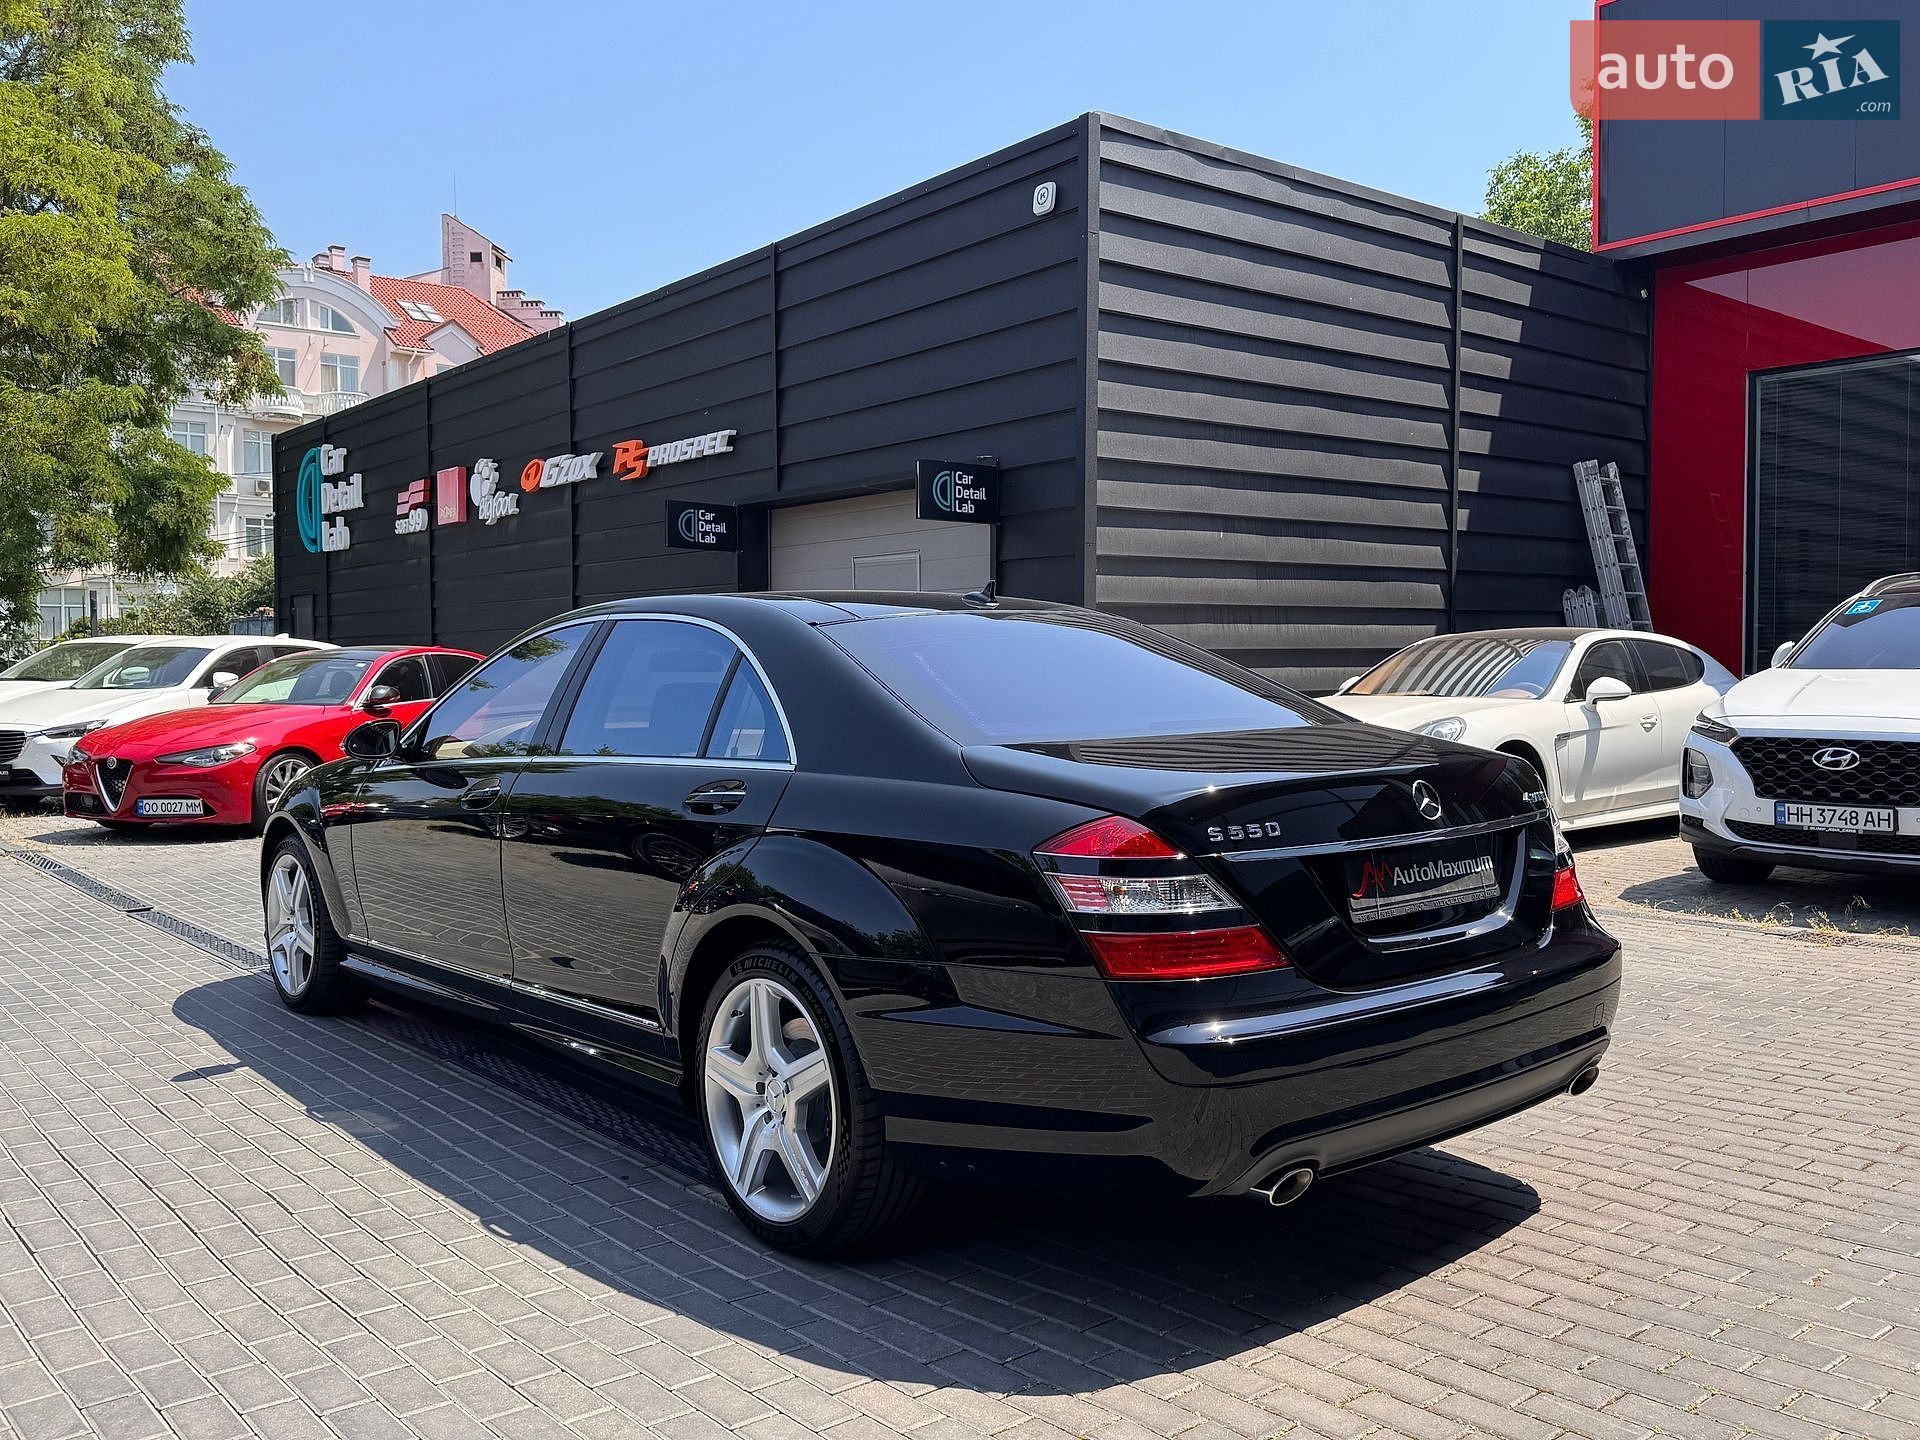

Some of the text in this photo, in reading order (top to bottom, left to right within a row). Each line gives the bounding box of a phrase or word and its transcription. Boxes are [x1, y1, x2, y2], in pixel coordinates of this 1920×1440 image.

[646, 429, 738, 467] PROSPEC
[320, 444, 348, 475] Car
[955, 471, 974, 485] Car
[321, 473, 364, 515] Detail
[955, 485, 987, 500] Detail
[955, 500, 975, 513] Lab
[698, 509, 716, 520] Car
[698, 521, 727, 533] Detail
[698, 532, 716, 544] Lab
[161, 801, 183, 813] 0027
[186, 801, 202, 813] MM
[1787, 806, 1891, 829] HH 3748 AH
[1393, 855, 1494, 887] AutoMaximum
[744, 957, 799, 983] MICHELIN
